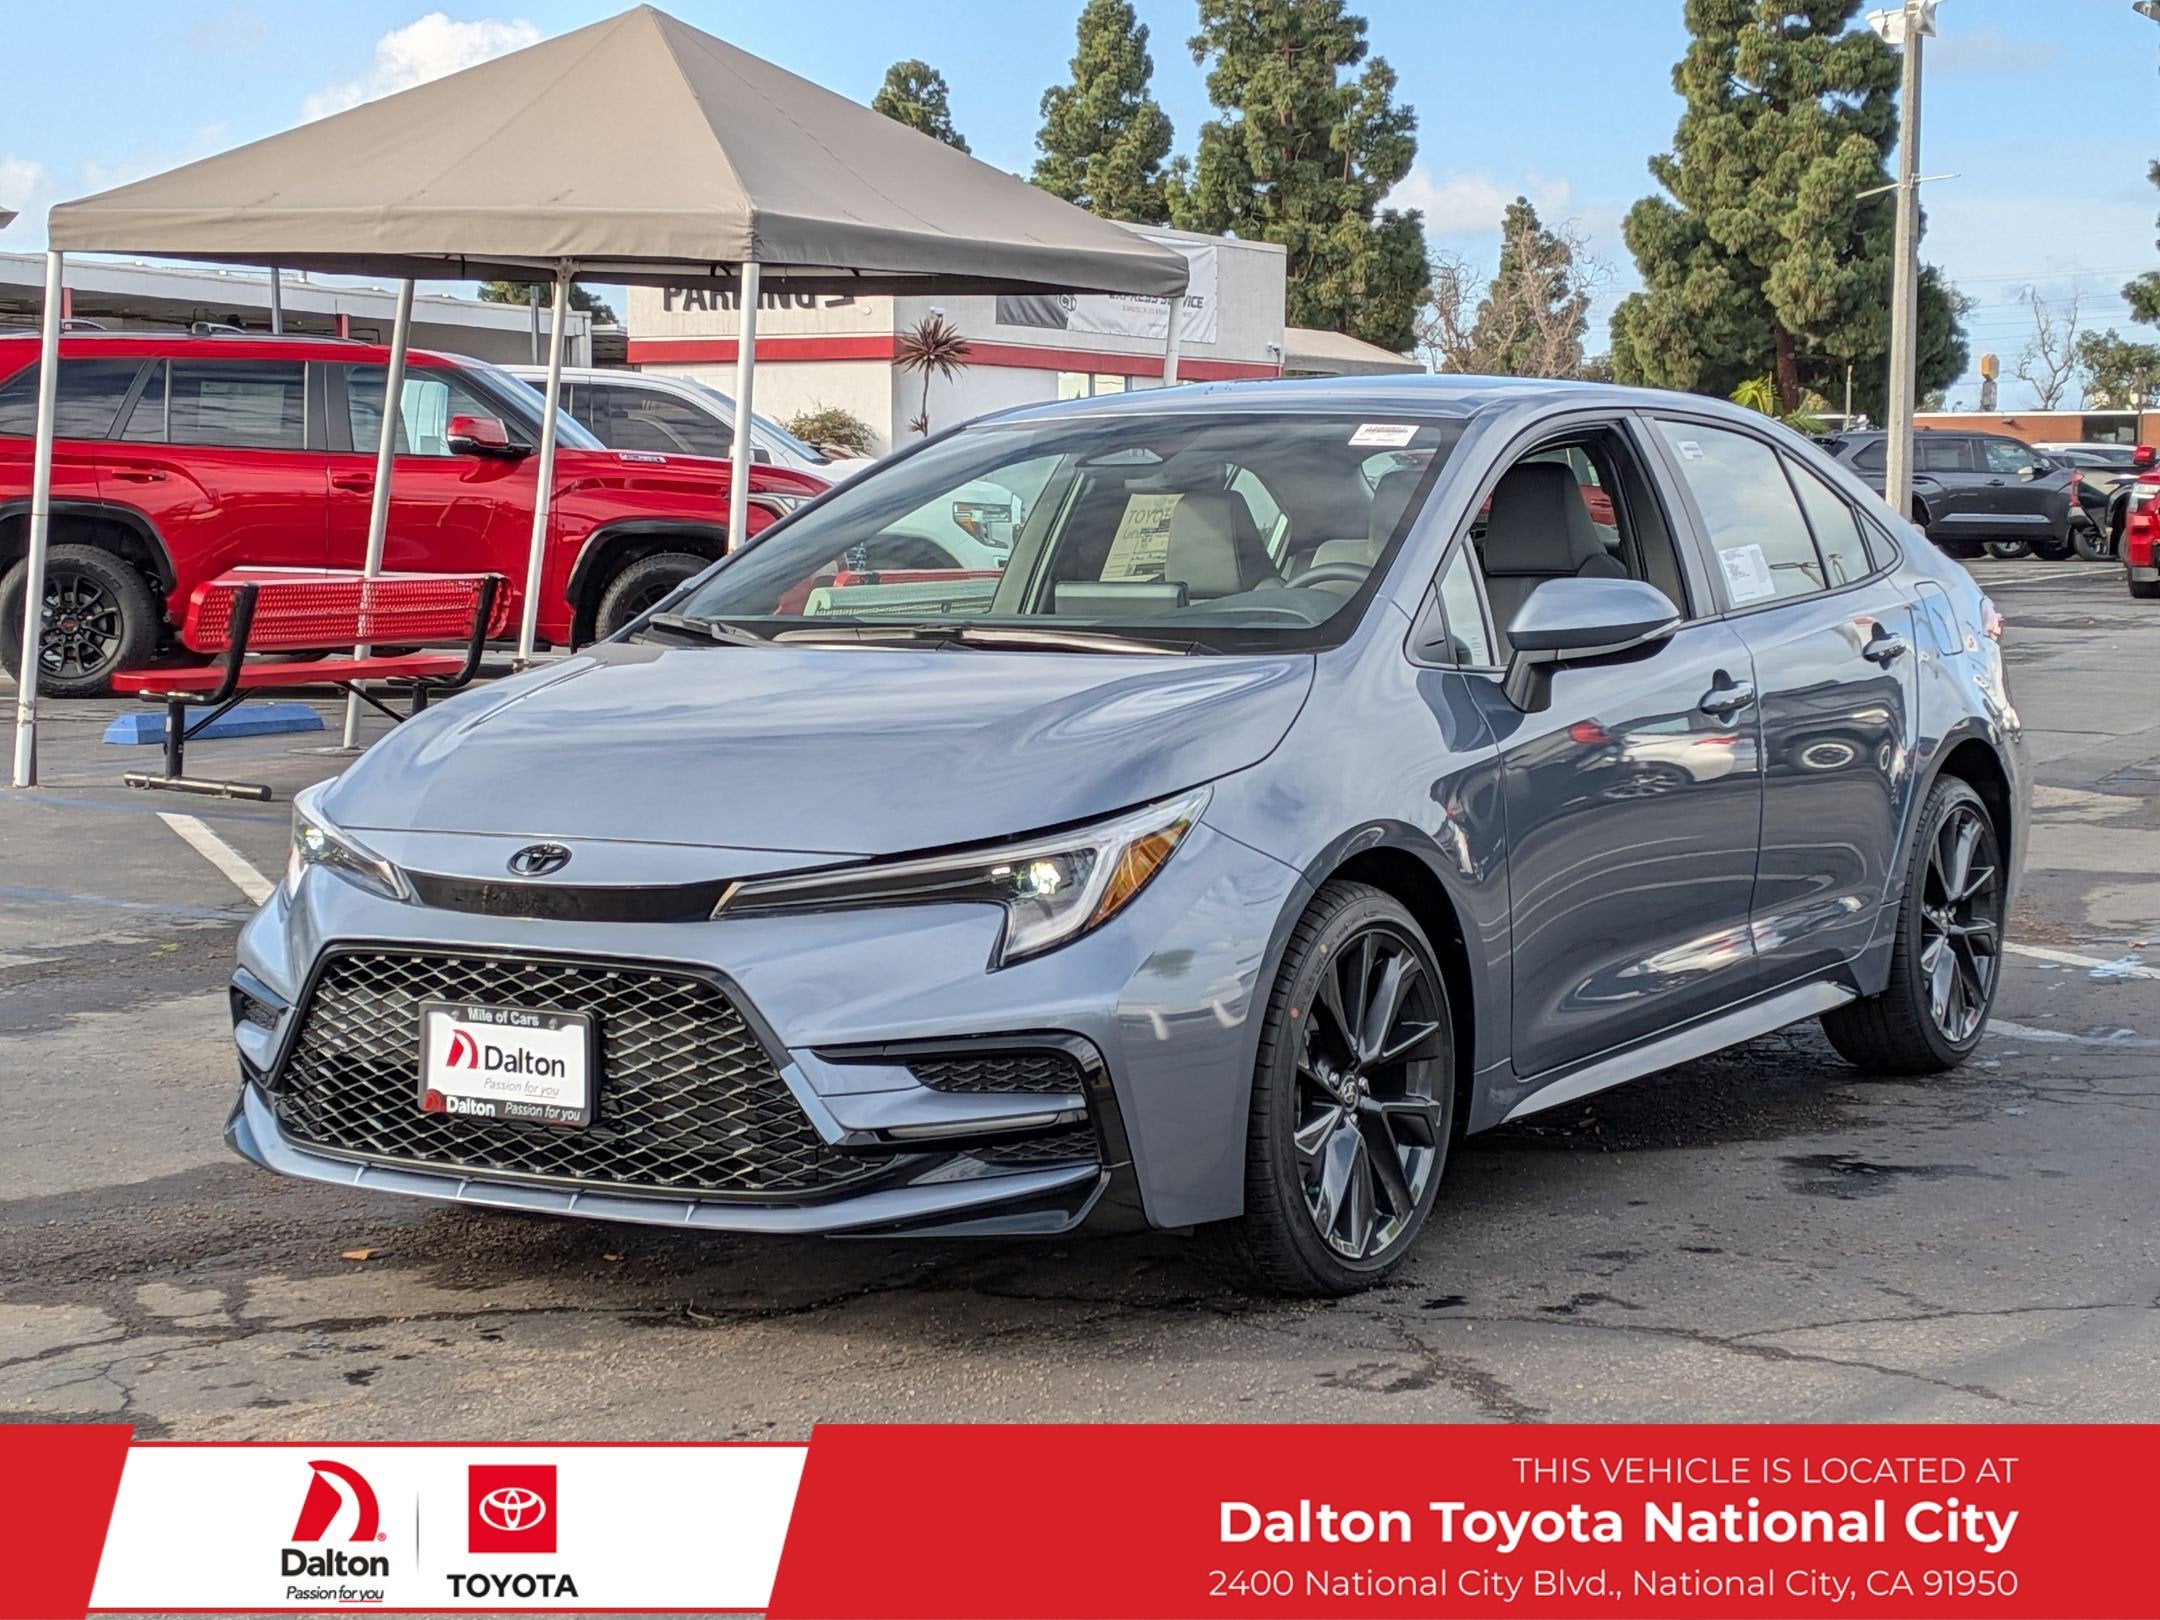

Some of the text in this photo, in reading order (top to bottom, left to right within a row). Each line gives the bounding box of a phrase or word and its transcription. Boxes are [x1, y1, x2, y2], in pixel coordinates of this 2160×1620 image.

[663, 287, 816, 312] PARING
[467, 1007, 540, 1026] Mile of Cars
[484, 1045, 566, 1078] Dalton
[483, 1077, 560, 1097] Passion for you
[446, 1095, 496, 1117] Dalton
[504, 1102, 581, 1122] Passion for you
